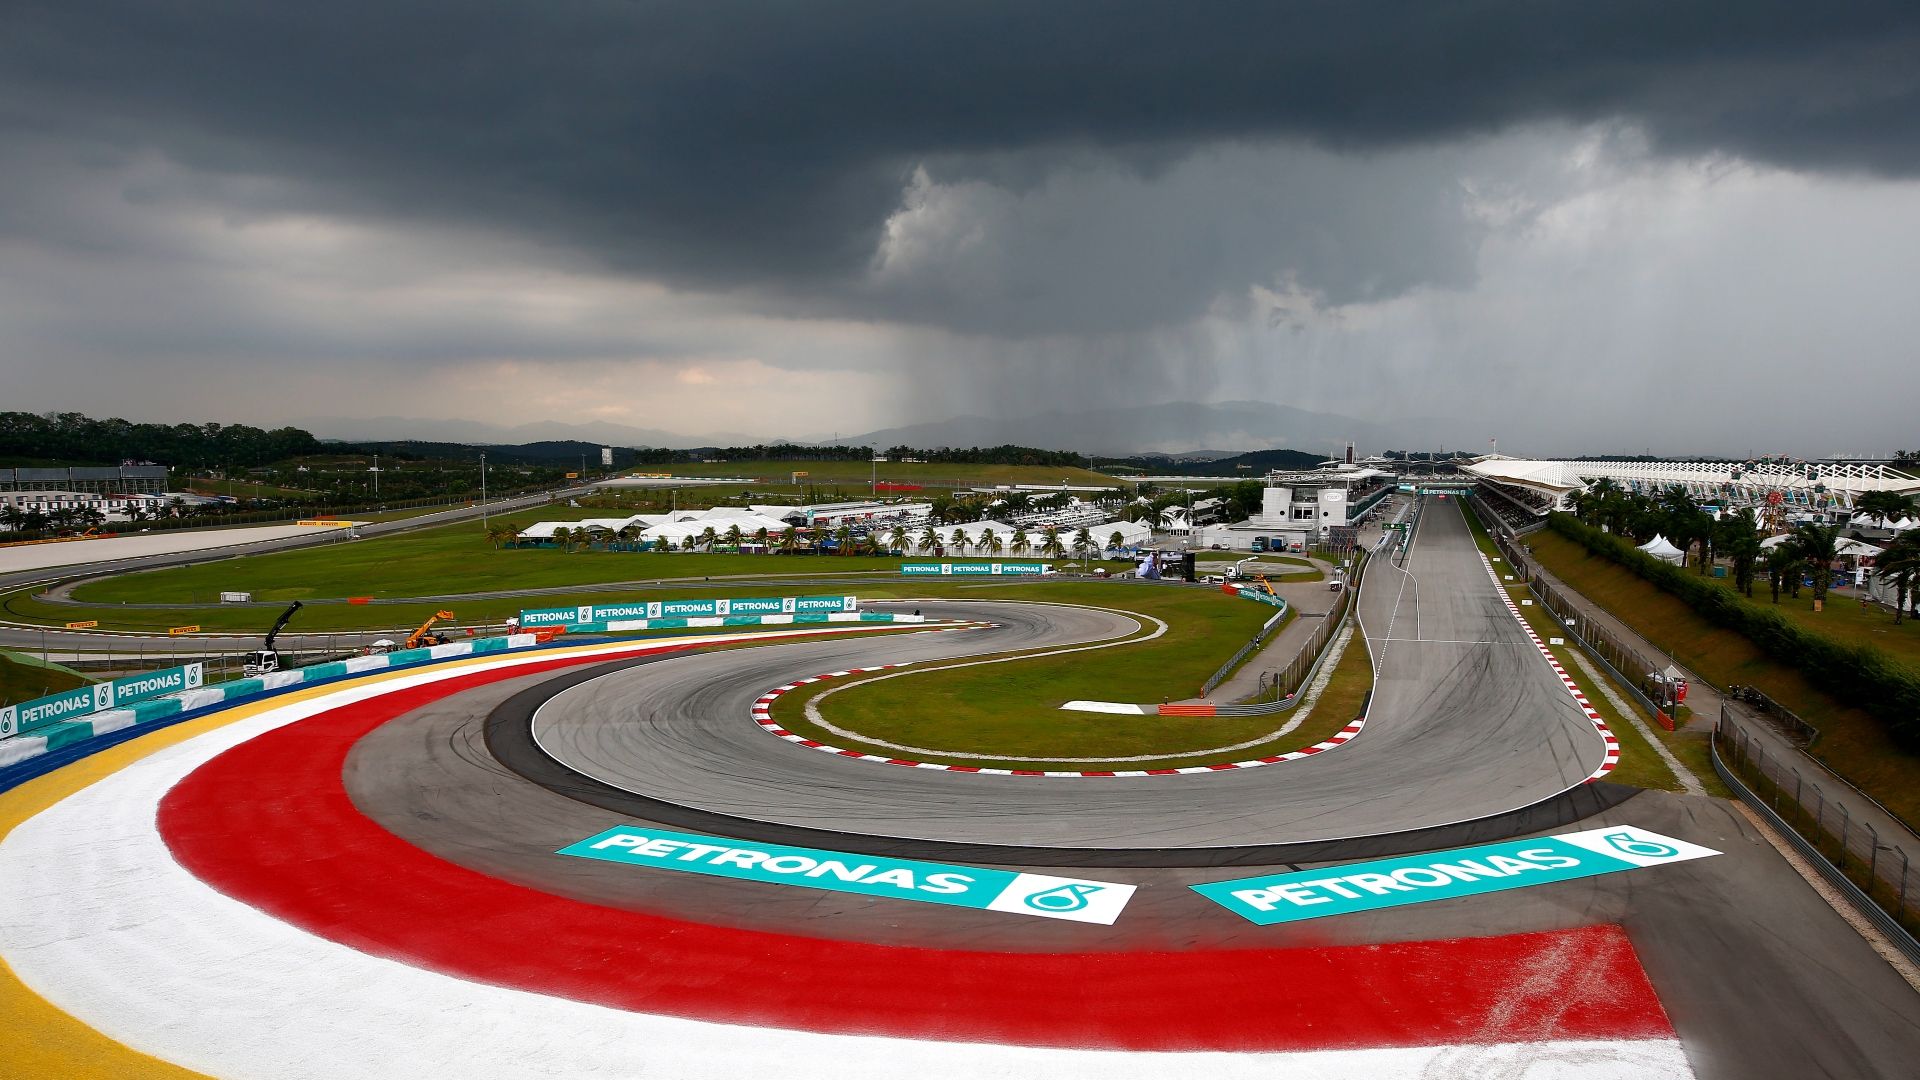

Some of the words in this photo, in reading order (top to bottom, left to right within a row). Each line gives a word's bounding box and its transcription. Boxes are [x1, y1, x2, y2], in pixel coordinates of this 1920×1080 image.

[664, 603, 713, 613] PETRONAS
[732, 602, 780, 611] PETRONAS
[798, 601, 841, 609] PETRONAS
[524, 611, 575, 623] PETRONAS
[595, 606, 645, 618] PETRONAS
[117, 673, 181, 698] PETRONAS
[22, 694, 90, 724] PETRONAS
[590, 834, 976, 894] PETRONAS
[1231, 848, 1581, 911] PETRONAS
